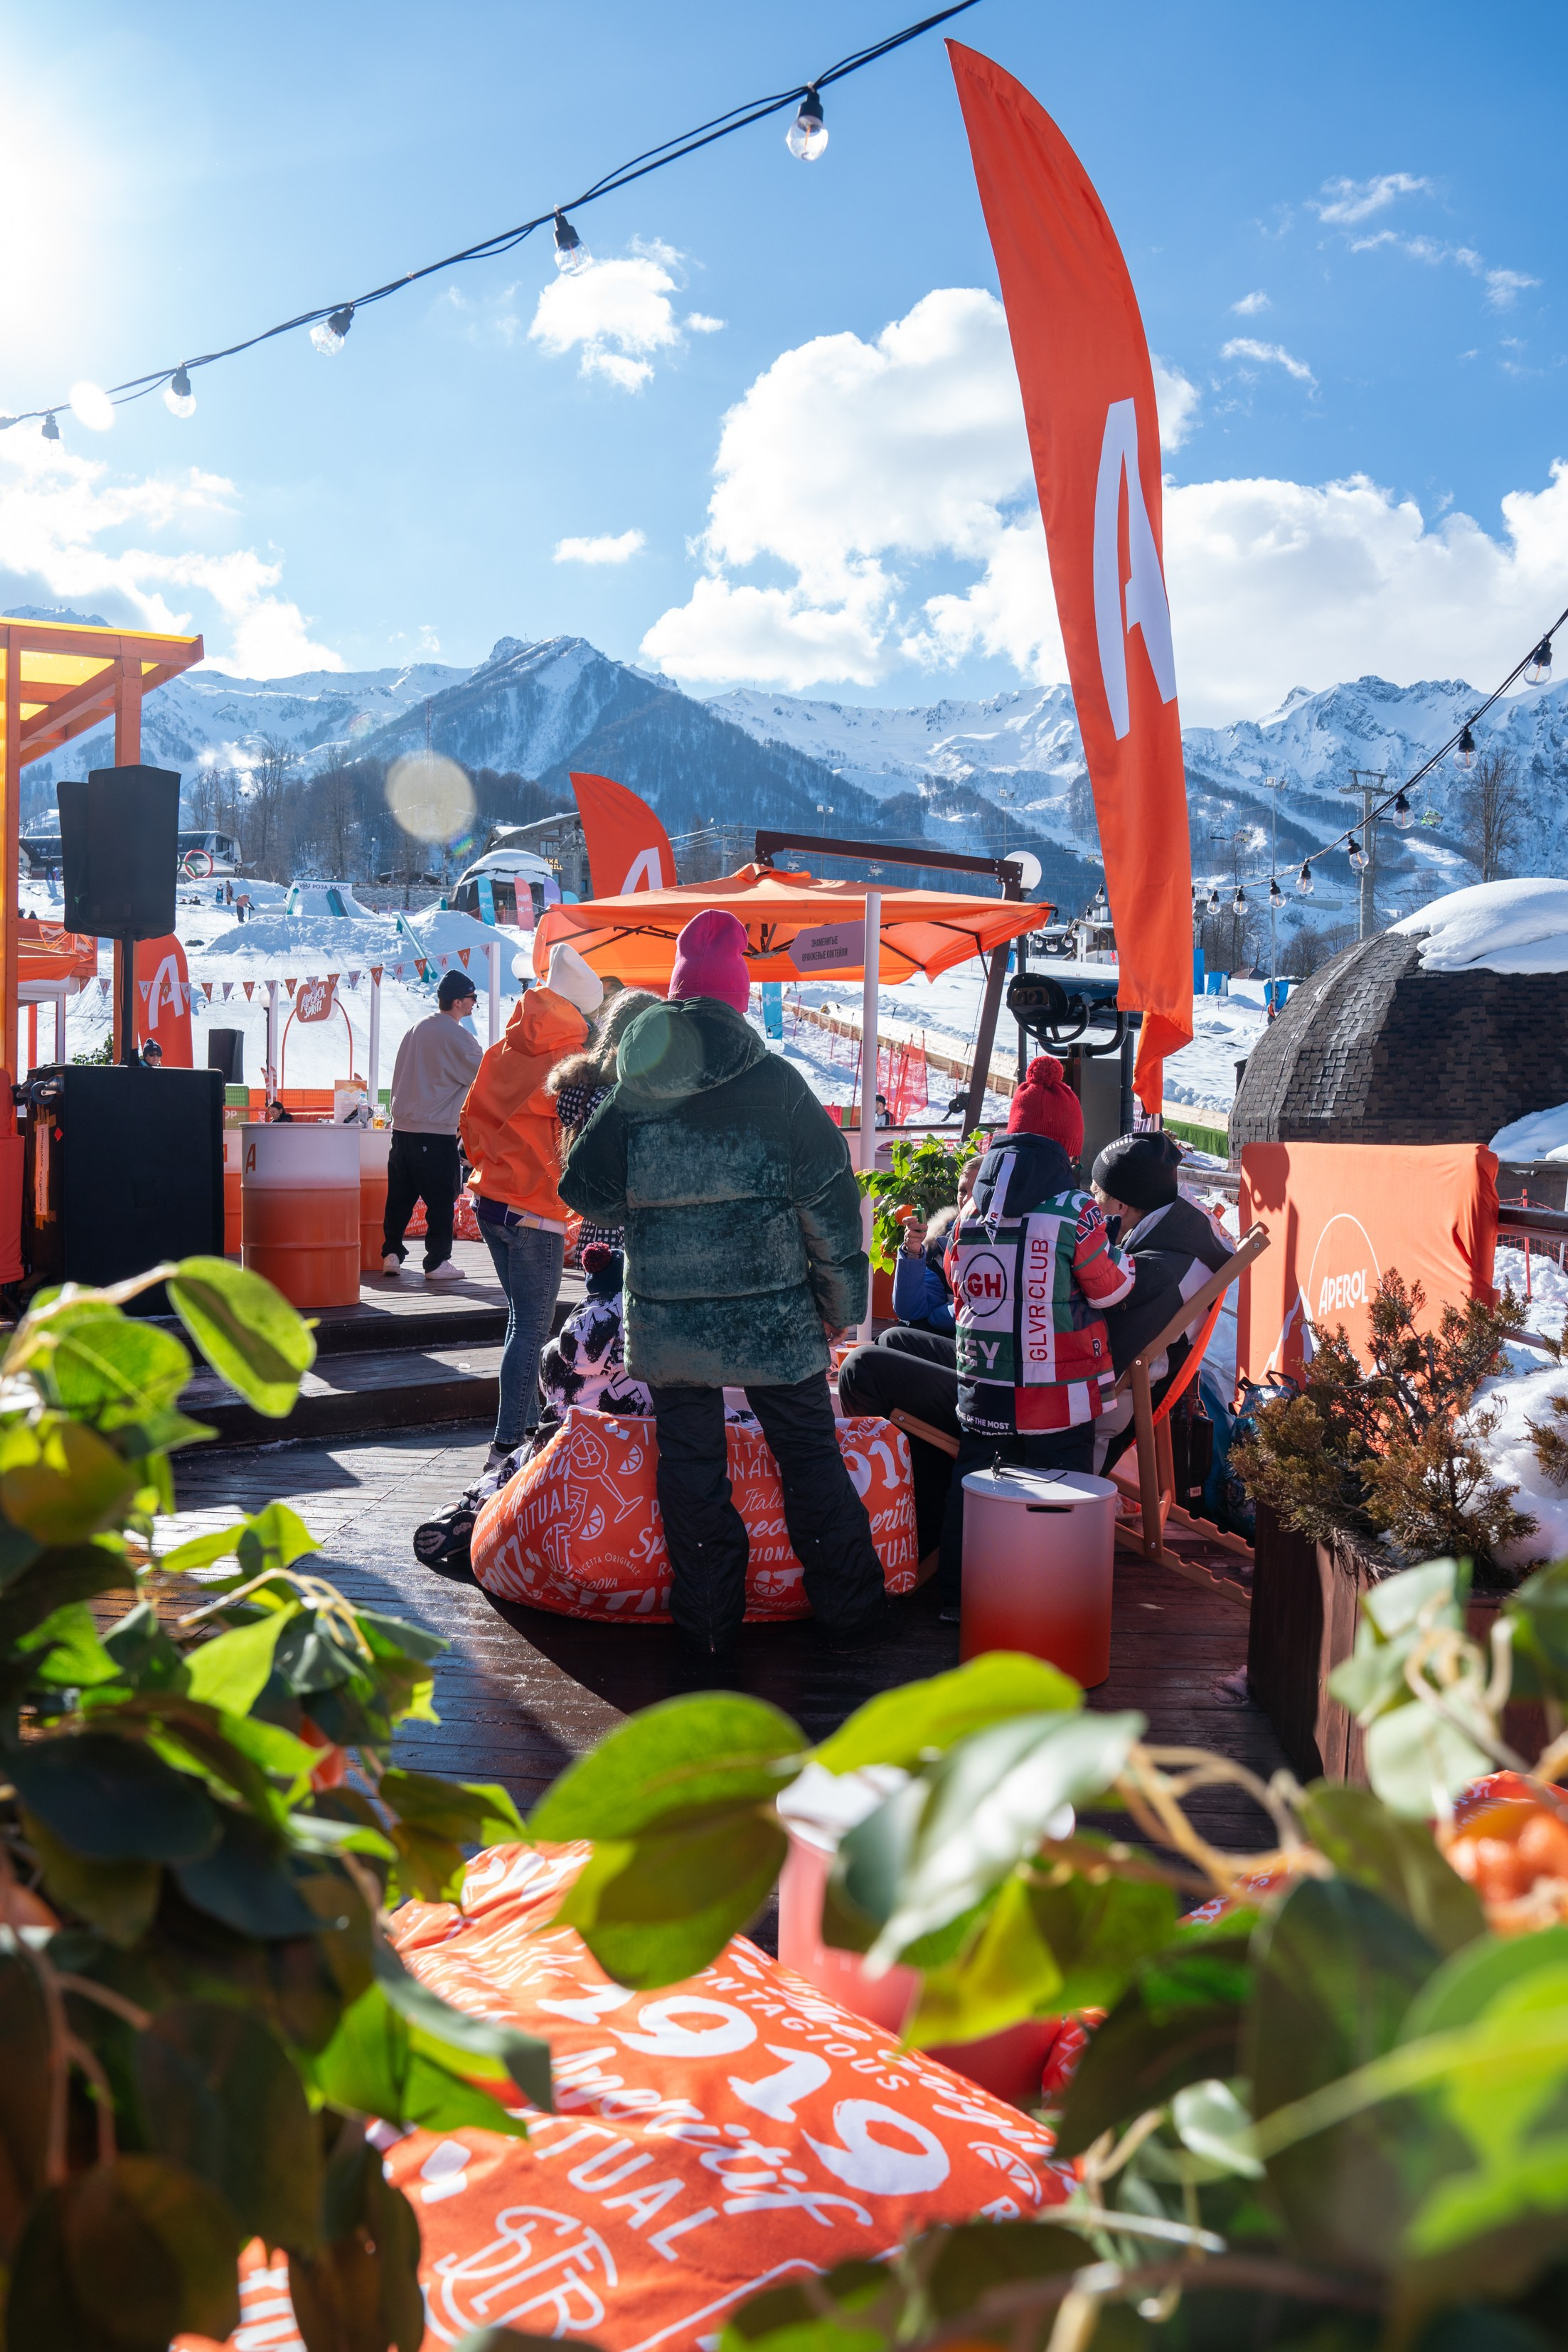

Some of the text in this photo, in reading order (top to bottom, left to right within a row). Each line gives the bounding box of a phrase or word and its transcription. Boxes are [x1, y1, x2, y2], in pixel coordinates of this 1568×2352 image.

[1093, 397, 1177, 740] A
[802, 947, 848, 962] ОРАНЖЕВЫЕ КОКТЕЙЛИ
[811, 936, 838, 947] ЗНАМЕНИТЫЕ
[245, 1142, 256, 1174] A
[1075, 1205, 1105, 1245] LVR
[967, 1272, 1002, 1298] GH
[1318, 1269, 1369, 1317] APEROL
[965, 1339, 1001, 1370] EY
[975, 1417, 986, 1427] THE
[988, 1420, 1010, 1430] MOST
[731, 1442, 769, 1460] TTA
[516, 1483, 571, 1543] RITUAL
[739, 1486, 786, 1514] Itali
[575, 1555, 602, 1575] RICETTA
[604, 1553, 641, 1577] ORIGINALE
[748, 1545, 794, 1563] ZIONA
[875, 1533, 915, 1568] TUAL
[573, 1577, 618, 1590] PADOVA
[691, 1967, 910, 2091] NTAGIOUS
[527, 2117, 719, 2262] TUAL
